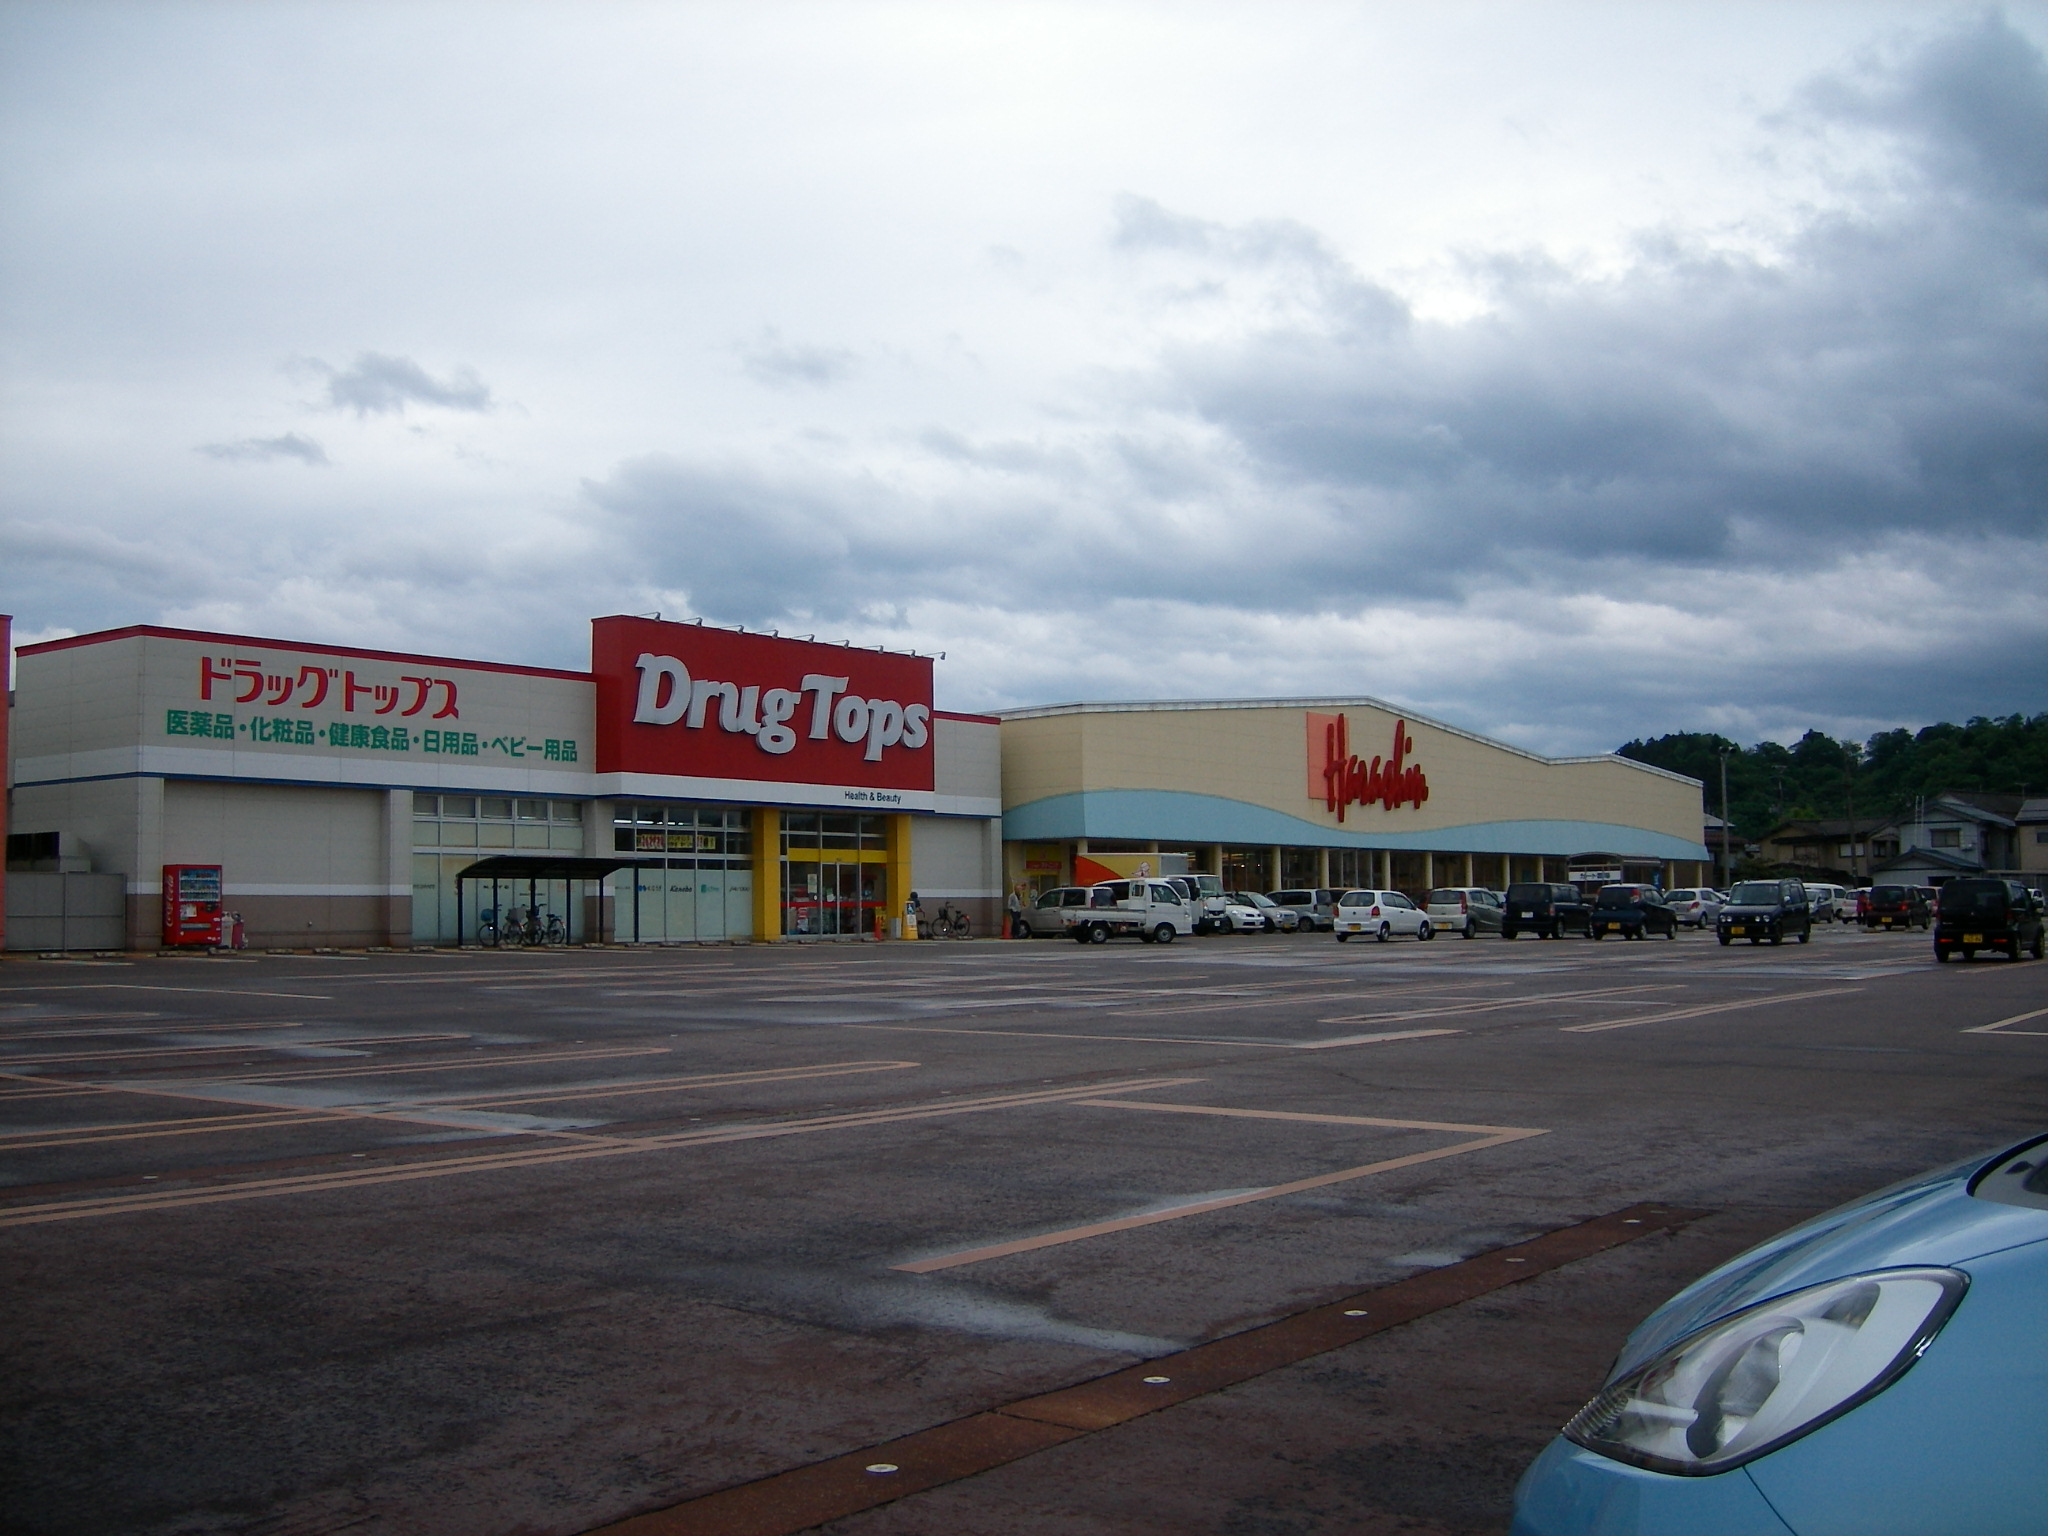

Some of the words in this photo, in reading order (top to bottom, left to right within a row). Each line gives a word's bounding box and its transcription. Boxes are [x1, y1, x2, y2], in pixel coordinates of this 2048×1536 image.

[201, 656, 460, 719] ドラッグトップス
[633, 652, 800, 755] Drug
[801, 674, 929, 762] Tops
[844, 791, 868, 801] Health
[869, 792, 875, 801] &
[877, 792, 902, 805] Beauty
